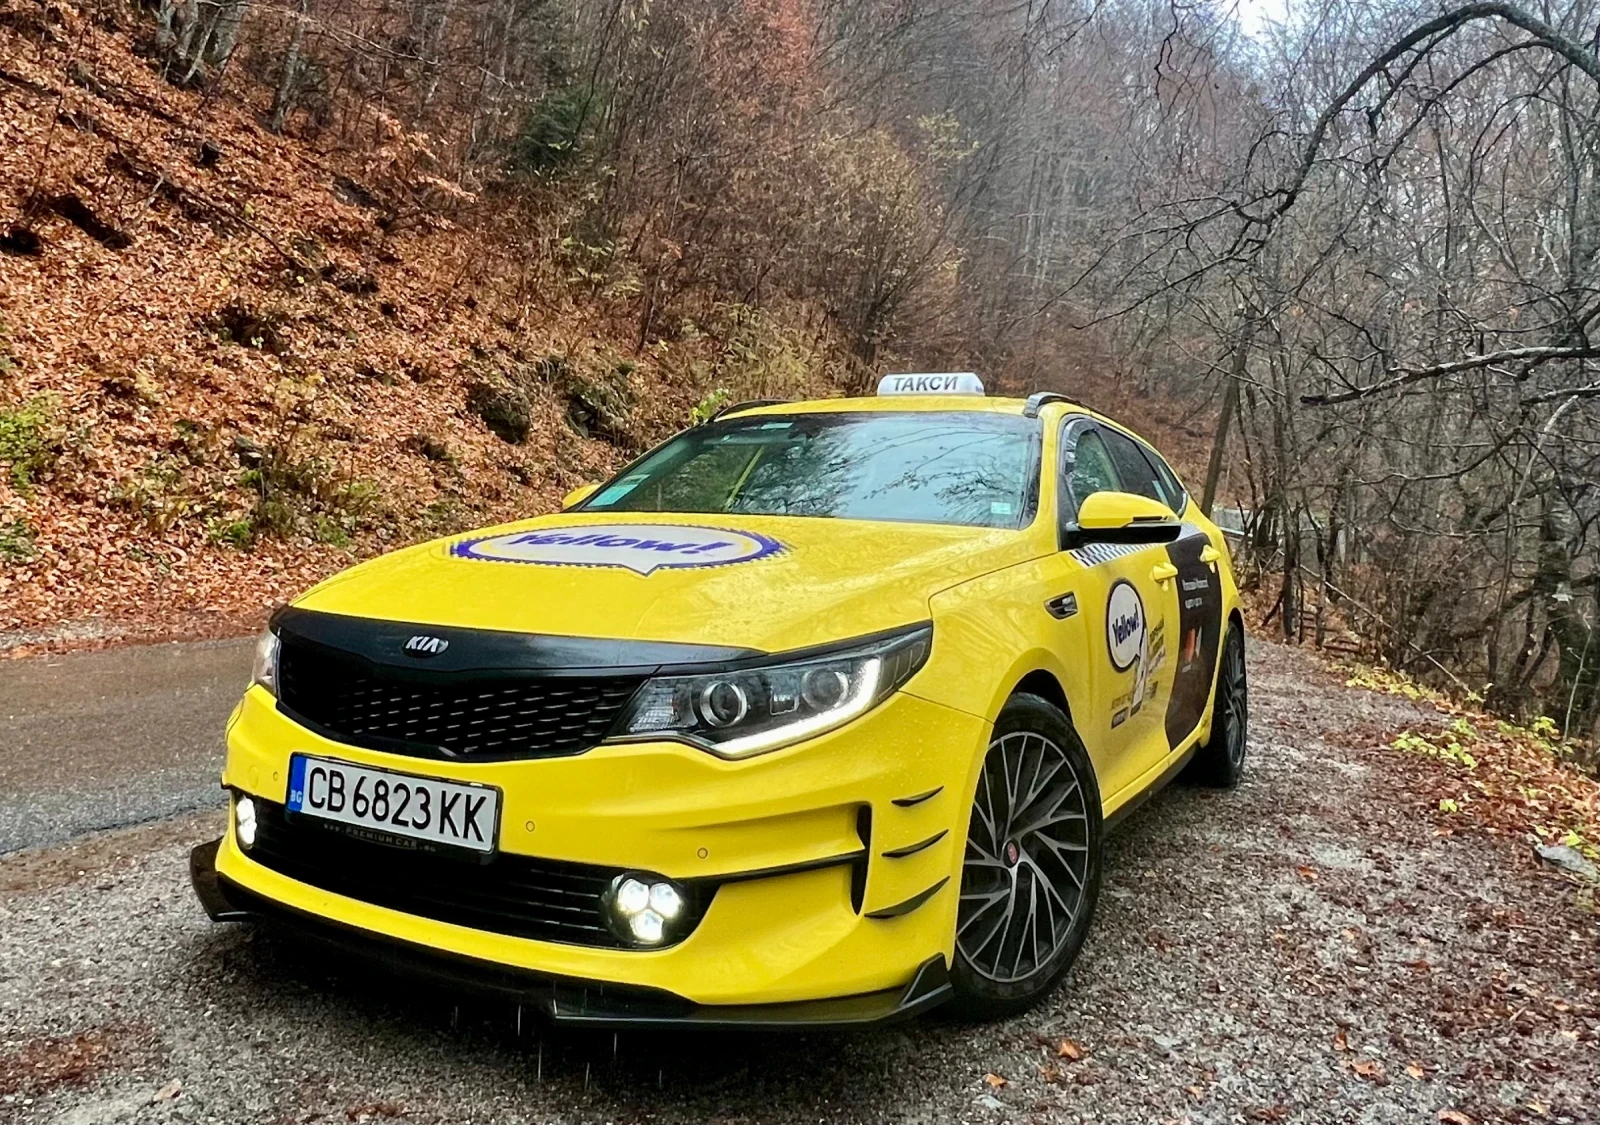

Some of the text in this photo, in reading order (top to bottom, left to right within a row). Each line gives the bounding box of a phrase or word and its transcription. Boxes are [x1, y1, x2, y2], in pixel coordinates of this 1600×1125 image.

[894, 376, 959, 391] ТАКСИ
[506, 533, 735, 554] Yellow!
[1112, 603, 1140, 648] Yellow!
[405, 635, 440, 653] KIA
[290, 789, 303, 804] BG
[352, 775, 431, 830] 6823
